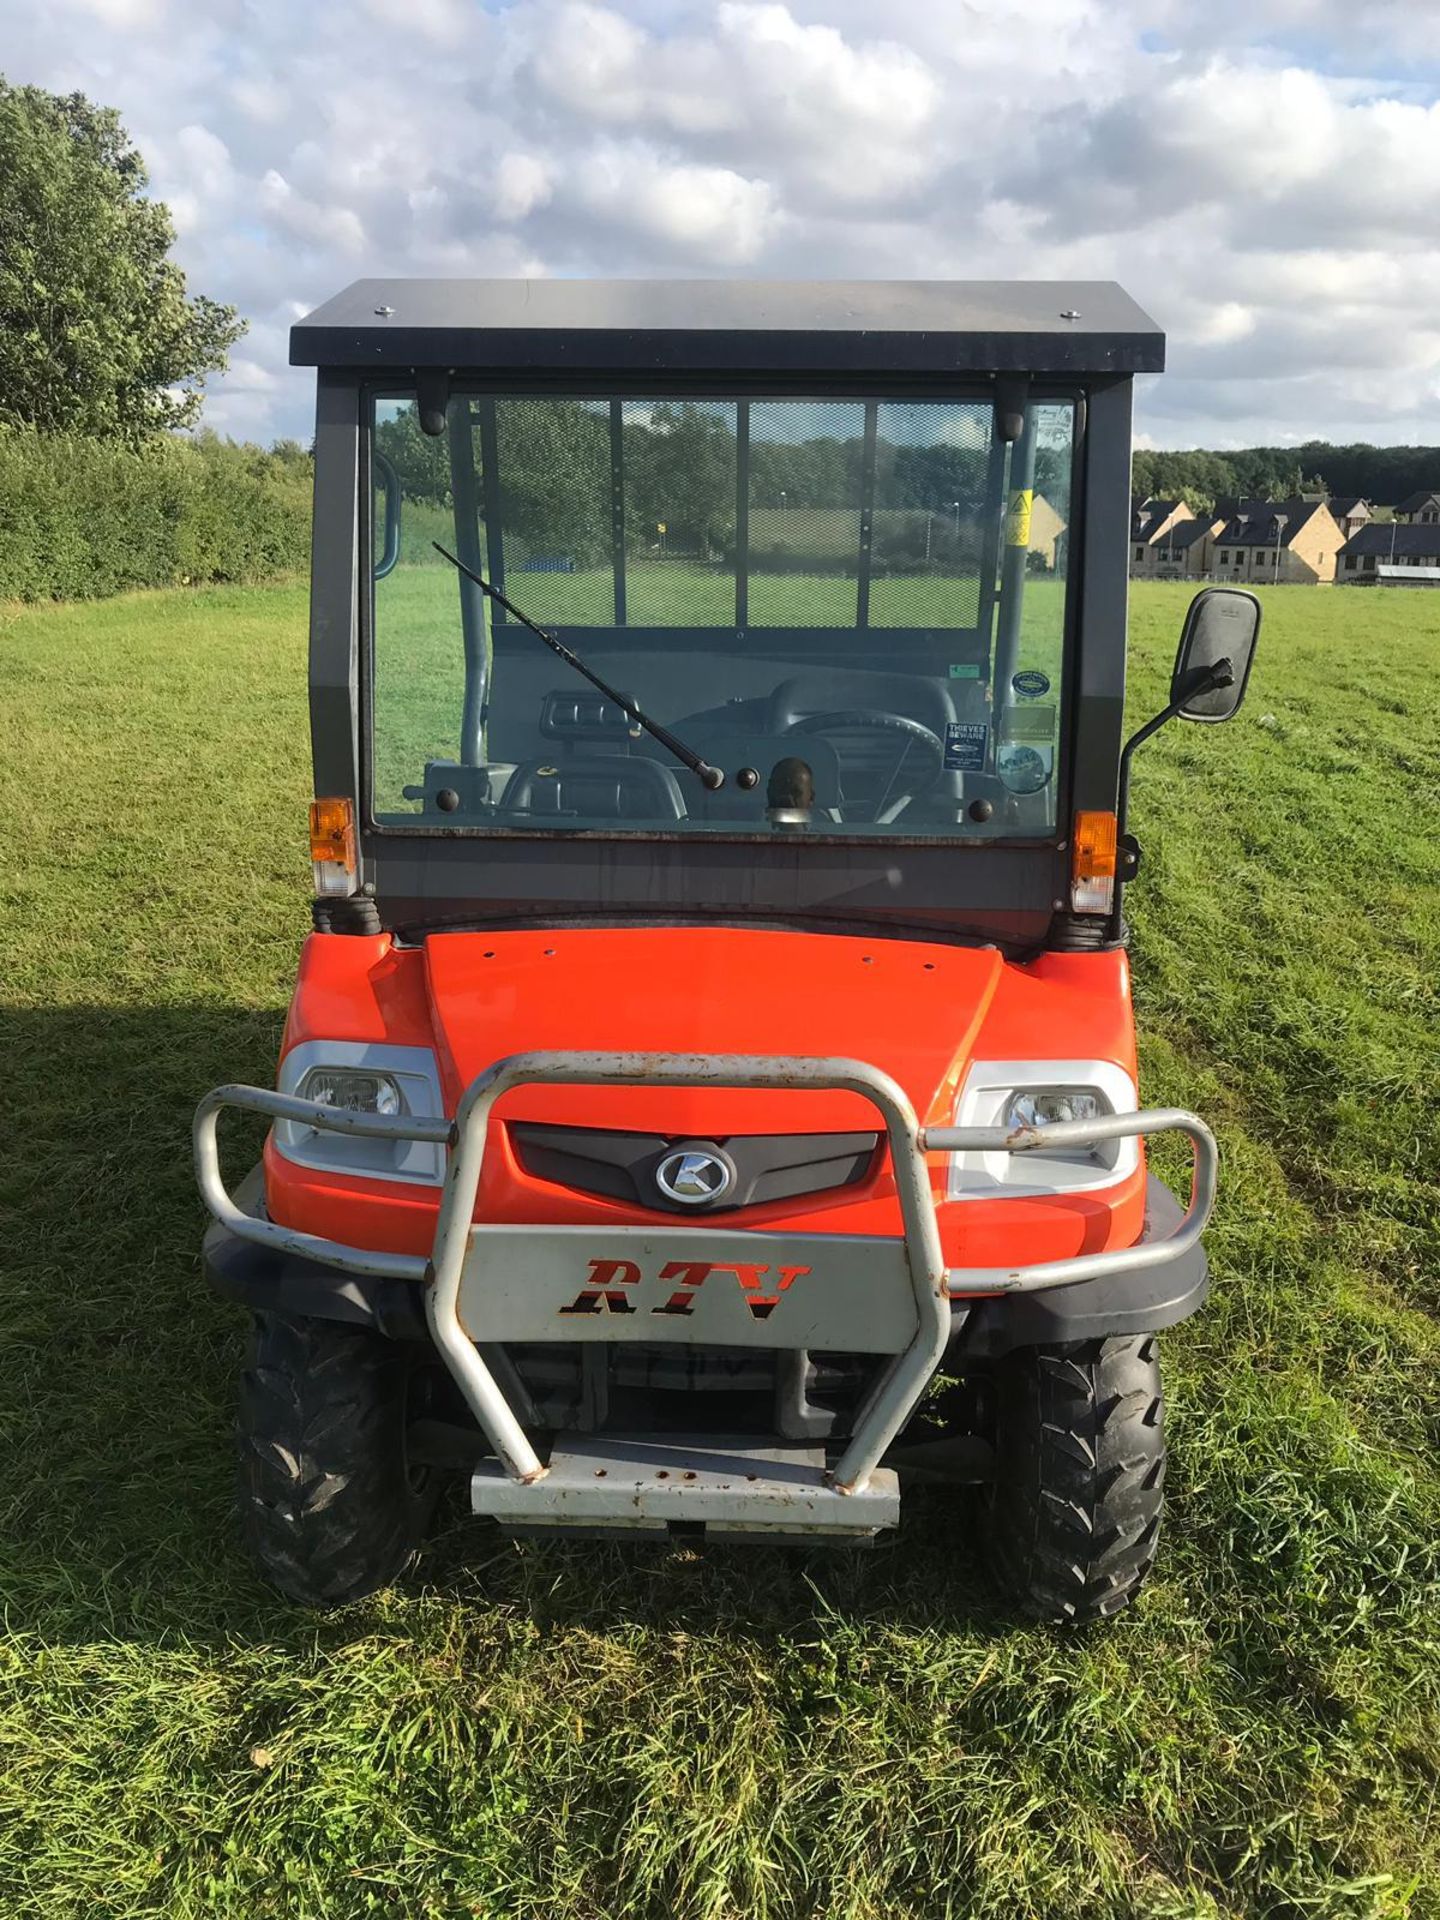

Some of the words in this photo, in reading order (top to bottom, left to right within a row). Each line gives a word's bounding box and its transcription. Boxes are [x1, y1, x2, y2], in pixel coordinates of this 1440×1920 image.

[950, 724, 985, 732] THIEVES
[949, 731, 984, 739] BEWARE
[558, 1258, 813, 1321] RTV
